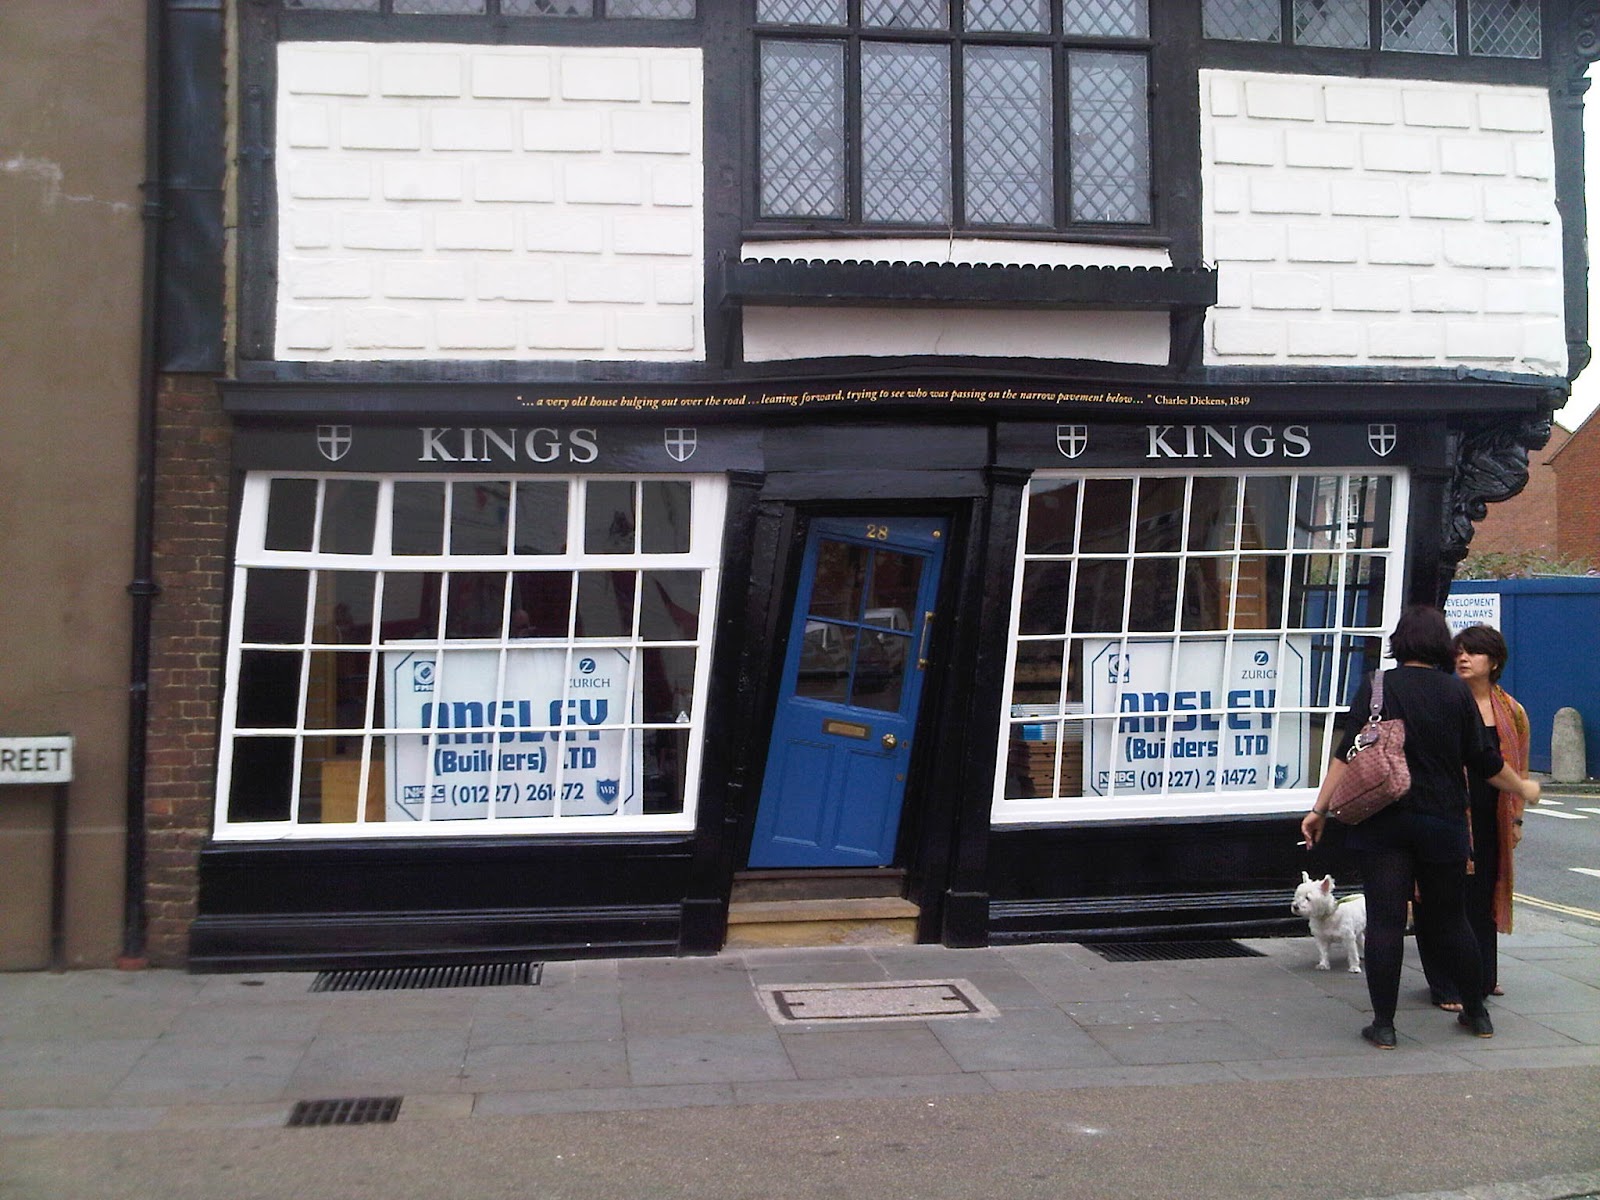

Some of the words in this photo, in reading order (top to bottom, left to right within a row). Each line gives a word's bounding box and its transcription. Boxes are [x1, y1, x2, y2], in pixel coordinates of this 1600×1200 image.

[545, 398, 569, 410] very
[571, 396, 588, 406] old
[589, 396, 617, 407] house
[619, 396, 659, 410] bulging
[661, 397, 678, 406] out
[680, 398, 703, 406] over
[704, 395, 721, 406] the
[799, 390, 845, 406] forward,
[846, 389, 878, 402] trying
[879, 389, 890, 398] to
[906, 388, 928, 398] who
[929, 390, 949, 398] was
[949, 389, 987, 402] passing
[1001, 389, 1017, 399] the
[1020, 391, 1056, 400] narrow
[1056, 392, 1104, 404] pavement
[1154, 394, 1188, 405] Charles
[1189, 395, 1228, 407] Dickens,
[1229, 396, 1251, 406] 1849
[417, 426, 600, 463] KINGS
[1145, 424, 1312, 459] KINGS
[866, 523, 889, 541] 28
[1446, 598, 1495, 607] EVELOPMENT
[569, 678, 611, 688] URICH
[421, 698, 609, 746] ANSLEY
[1118, 688, 1276, 734] ANSLEY
[0, 747, 67, 772] REET
[562, 746, 597, 770] TD
[1125, 735, 1219, 763] (Buiders
[1234, 734, 1270, 757] LTD
[404, 785, 445, 799] NHC
[526, 782, 584, 802] 26172
